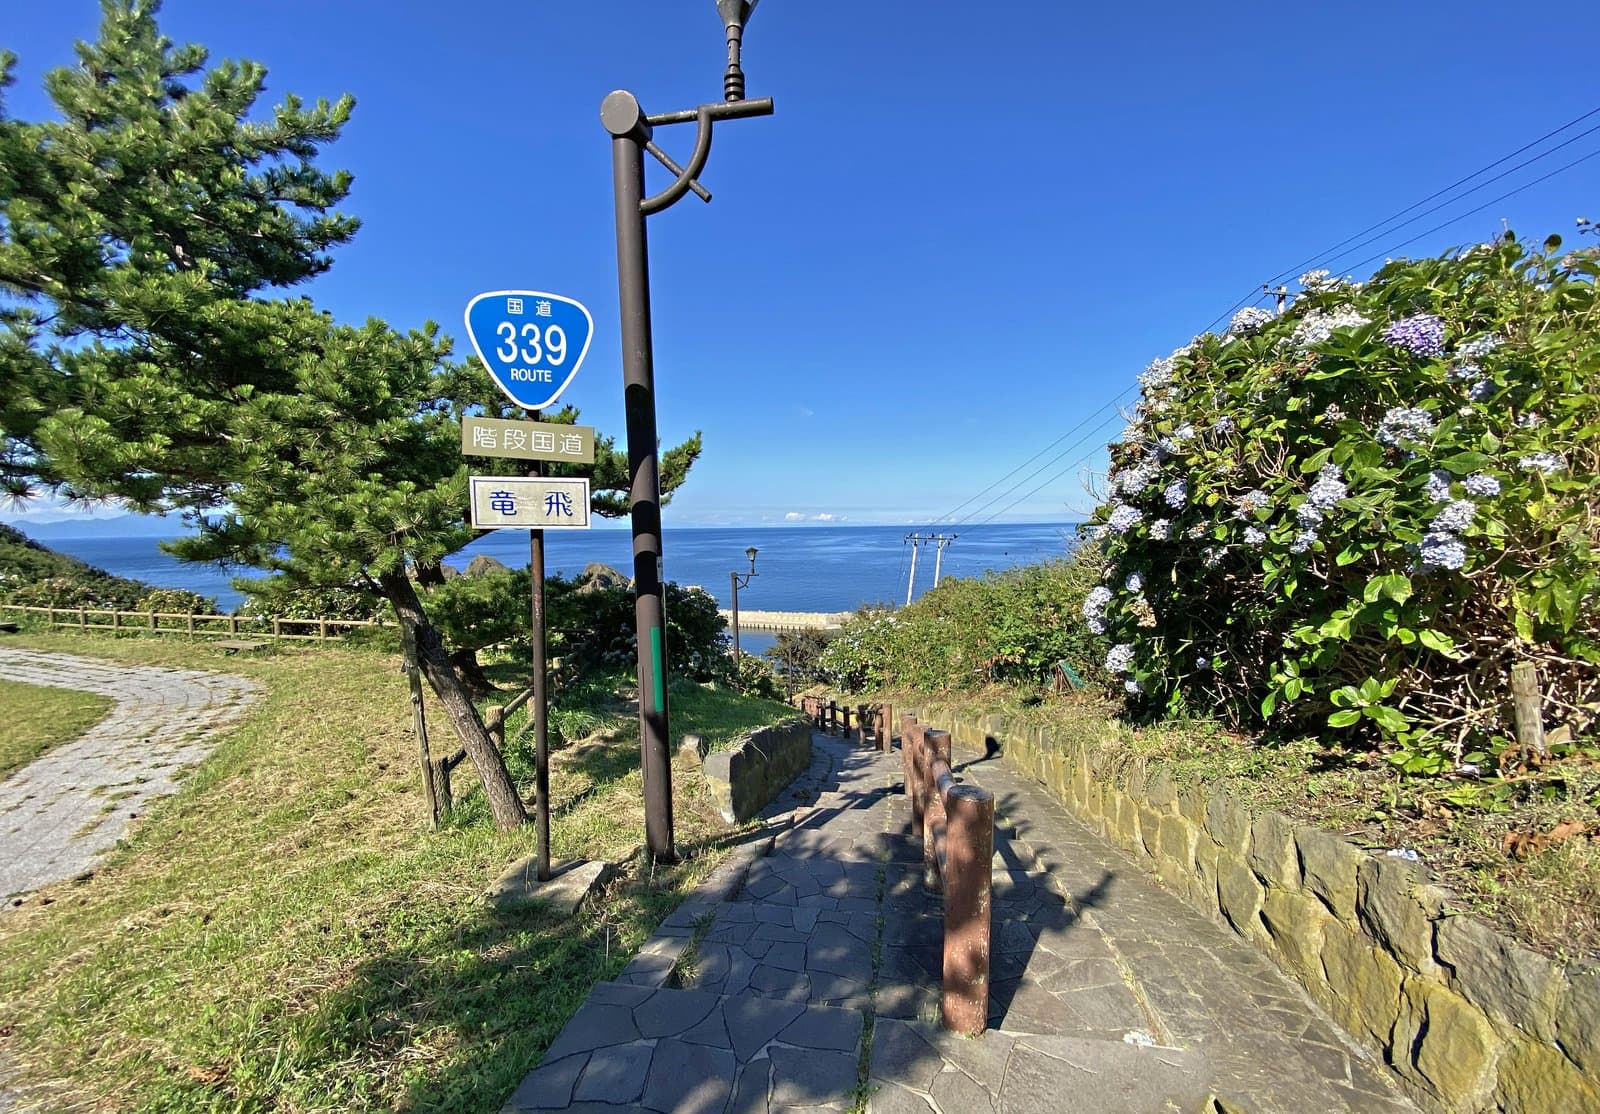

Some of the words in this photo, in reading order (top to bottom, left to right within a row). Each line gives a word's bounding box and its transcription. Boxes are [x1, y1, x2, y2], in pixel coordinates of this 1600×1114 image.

[507, 298, 552, 317] 国道
[496, 321, 567, 366] 339
[510, 368, 553, 383] ROUTE
[473, 426, 584, 455] 階段国道
[489, 490, 573, 517] 竜飛
